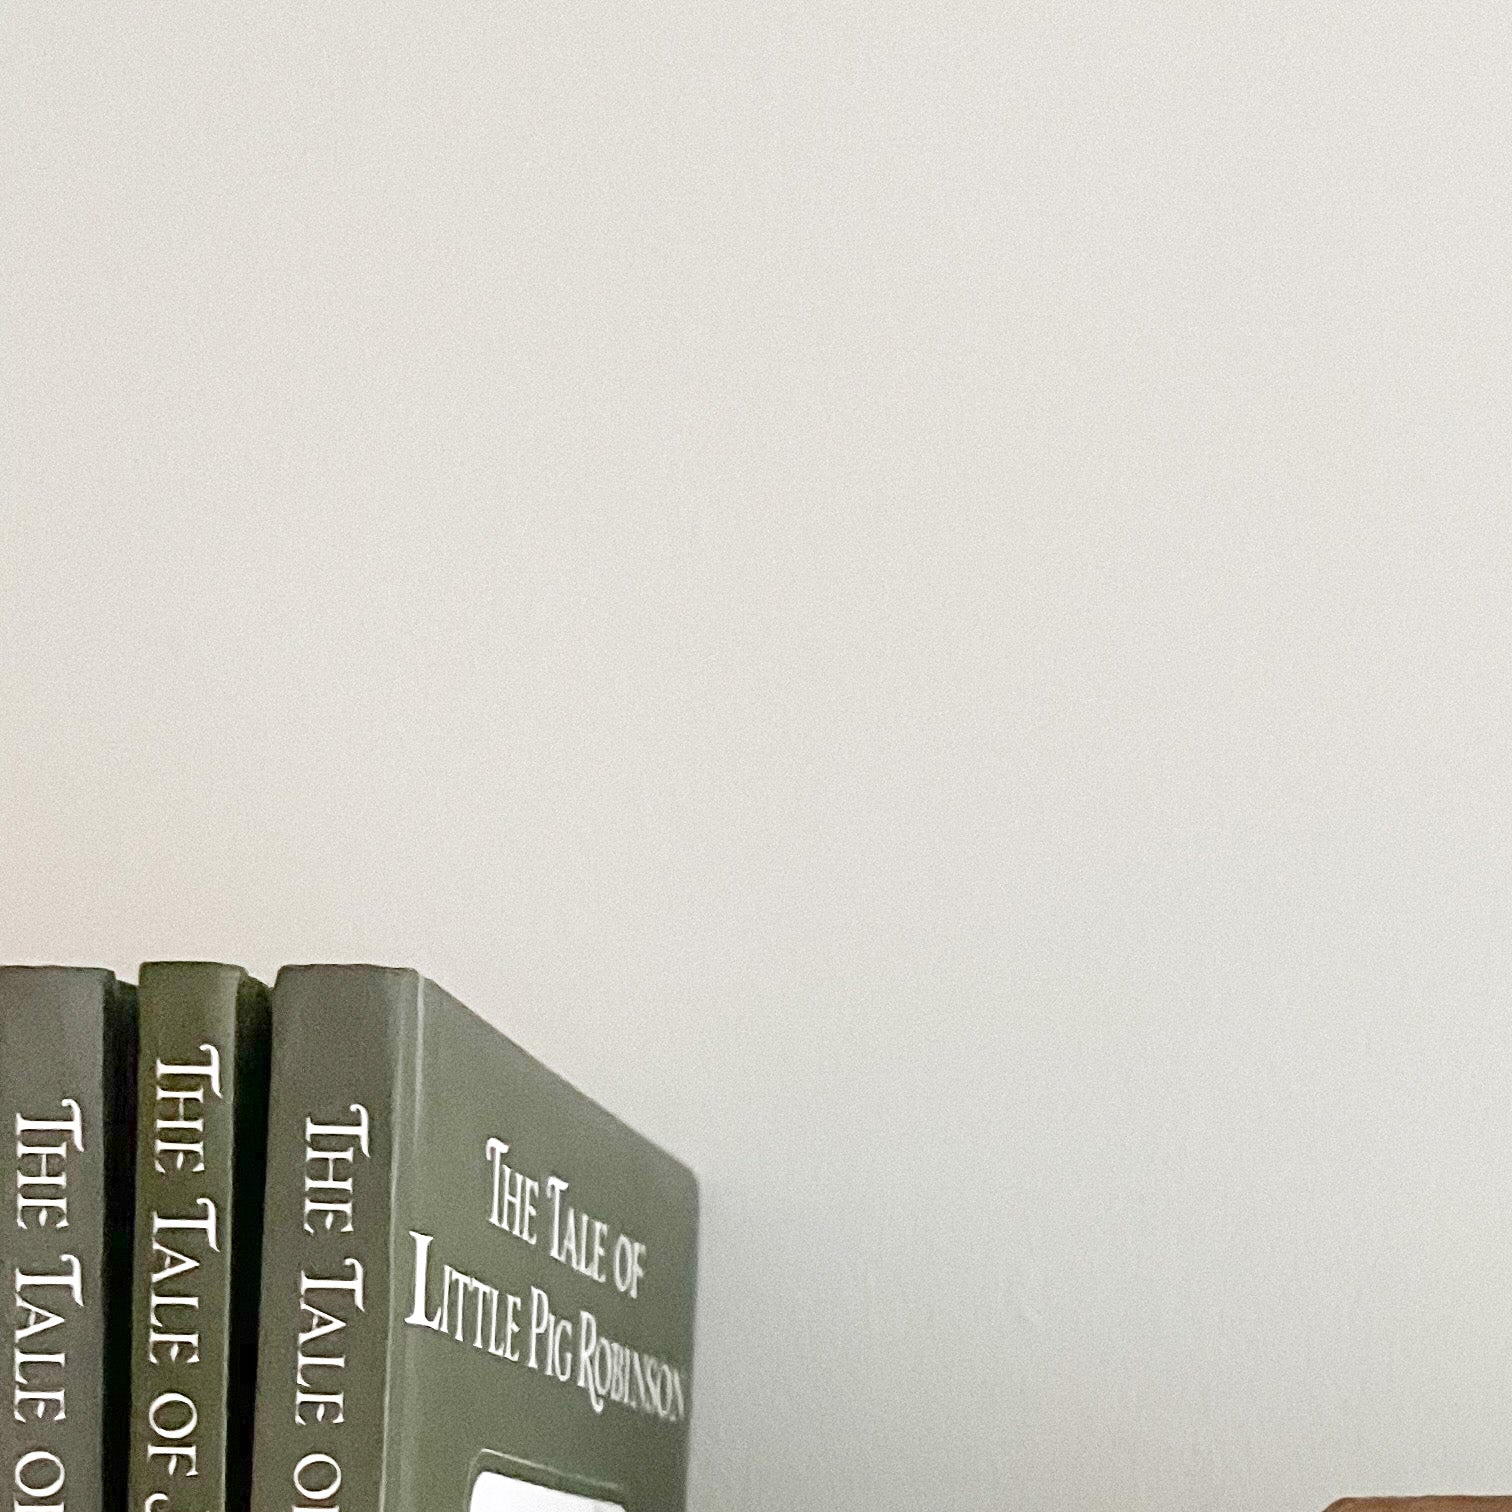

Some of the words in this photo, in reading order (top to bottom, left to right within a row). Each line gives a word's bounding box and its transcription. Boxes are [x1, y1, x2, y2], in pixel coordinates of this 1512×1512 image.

[16, 1099, 84, 1229] THE
[155, 1044, 222, 1173] THE
[304, 1104, 370, 1233] THE
[149, 1198, 219, 1363] TALE
[486, 1137, 540, 1245] THE
[547, 1176, 608, 1283] TALE
[613, 1234, 646, 1299] OF
[14, 1254, 83, 1422] TALE
[295, 1258, 364, 1425] TALE
[404, 1231, 521, 1362] LITTLE
[528, 1286, 573, 1382] PIG
[577, 1310, 685, 1422] ROBINSON
[148, 1393, 198, 1476] OF
